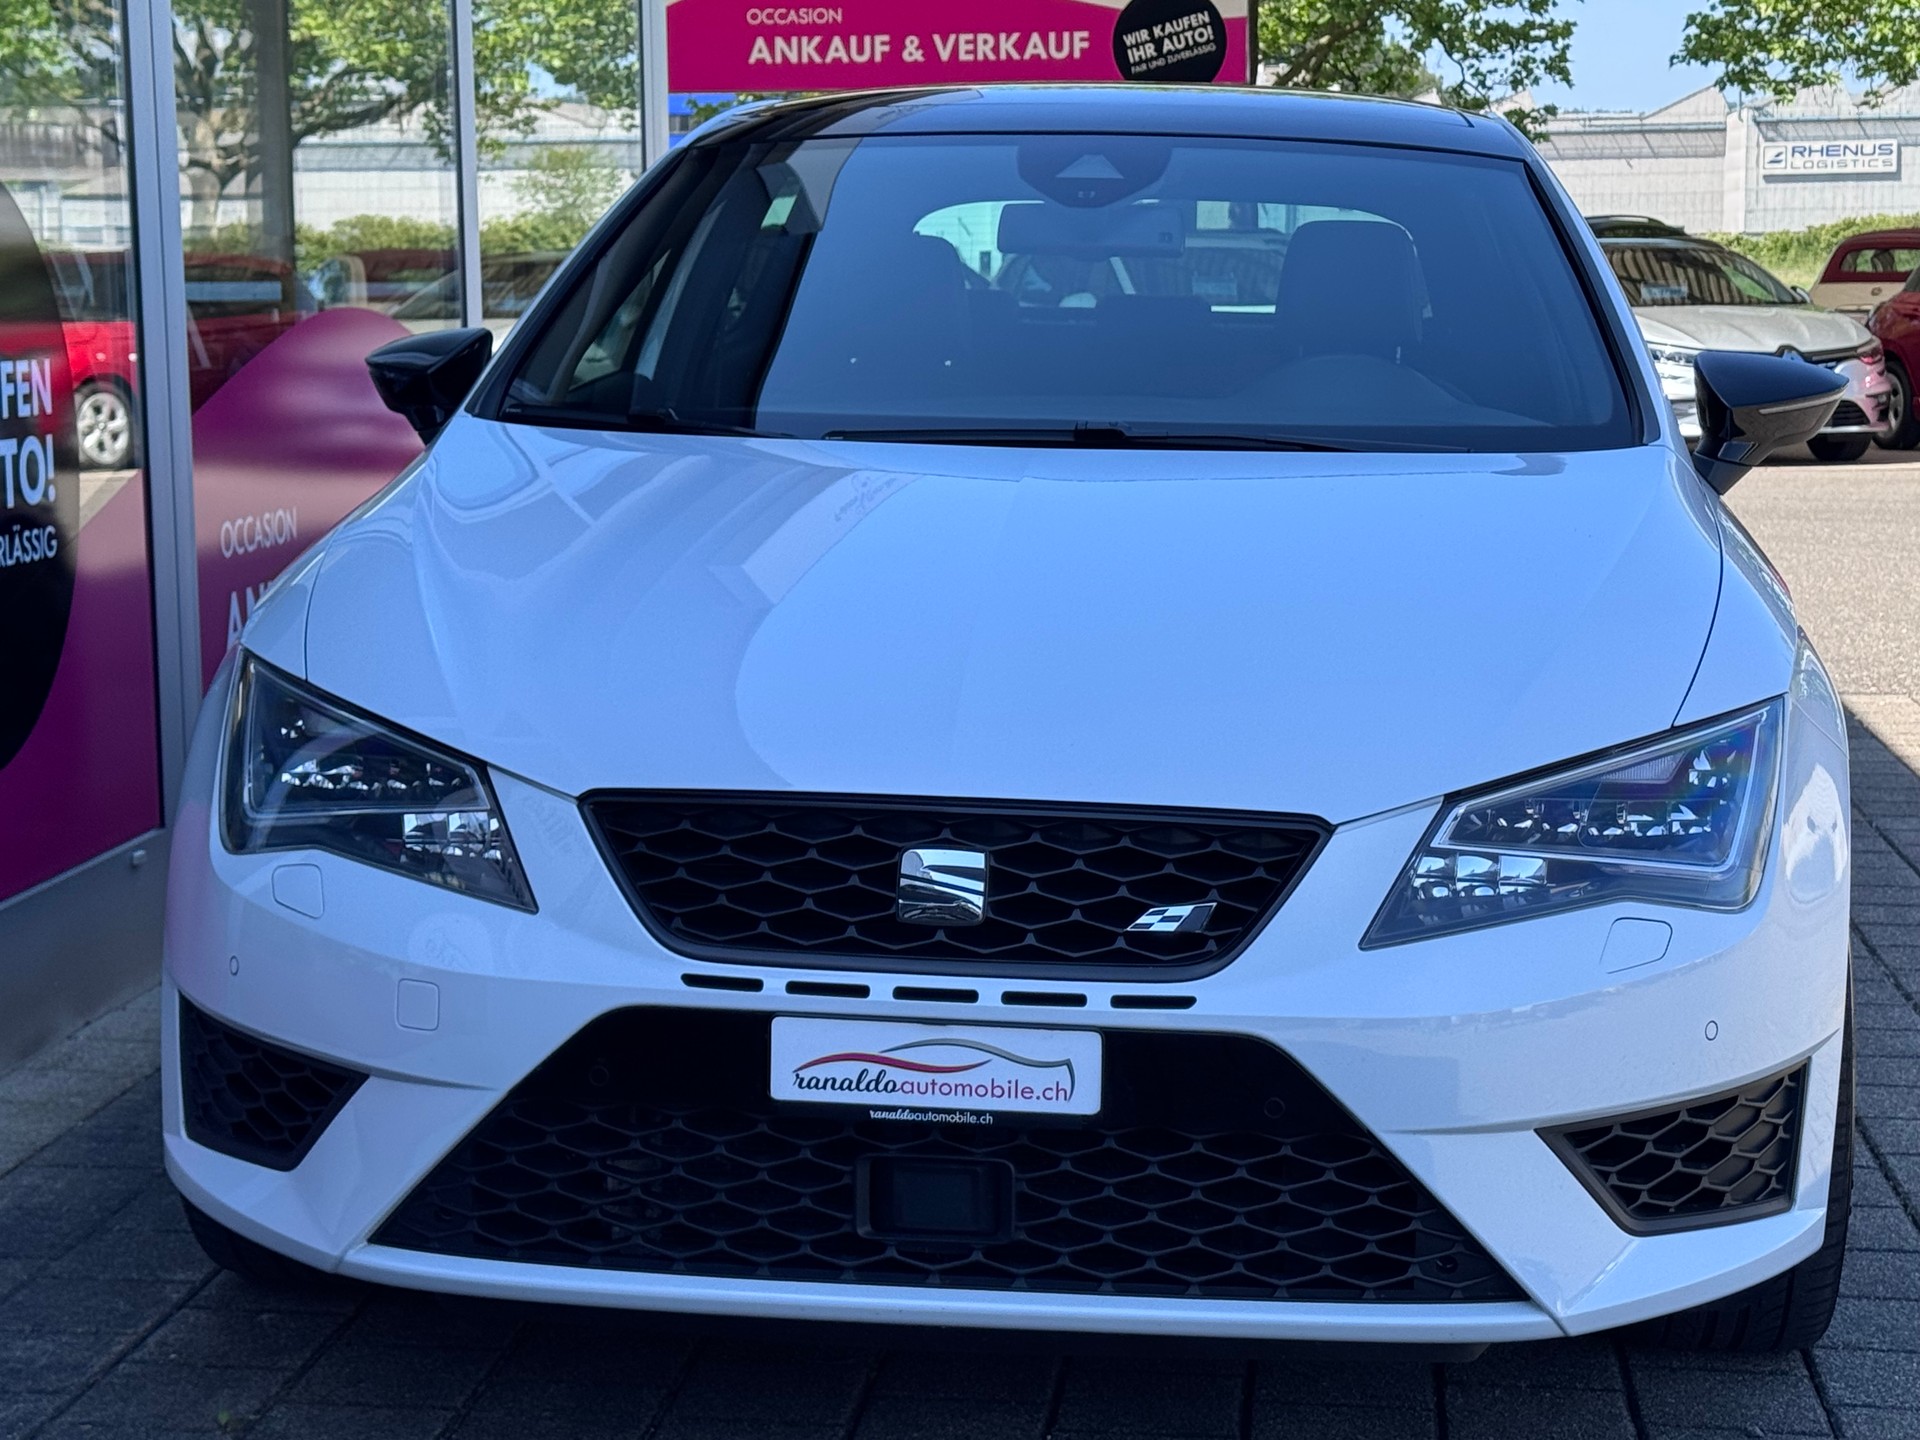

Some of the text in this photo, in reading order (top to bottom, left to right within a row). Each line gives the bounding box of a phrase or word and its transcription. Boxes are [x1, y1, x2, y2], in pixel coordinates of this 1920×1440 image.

[746, 7, 842, 25] OCCASION
[1122, 10, 1210, 47] WIR KAUFEN
[748, 30, 1090, 64] ANKAUF & VERKAUF
[1127, 25, 1215, 64] IHR AUTO!
[1130, 61, 1148, 74] FAIR
[1148, 57, 1167, 70] UND
[1791, 143, 1894, 158] RHENUS
[1790, 158, 1894, 170] LOGISTICS
[221, 506, 297, 559] OCCASION
[793, 1068, 1068, 1101] ranaldoautomobile.ch
[869, 1108, 994, 1125] ranaldoautomobile.ch
